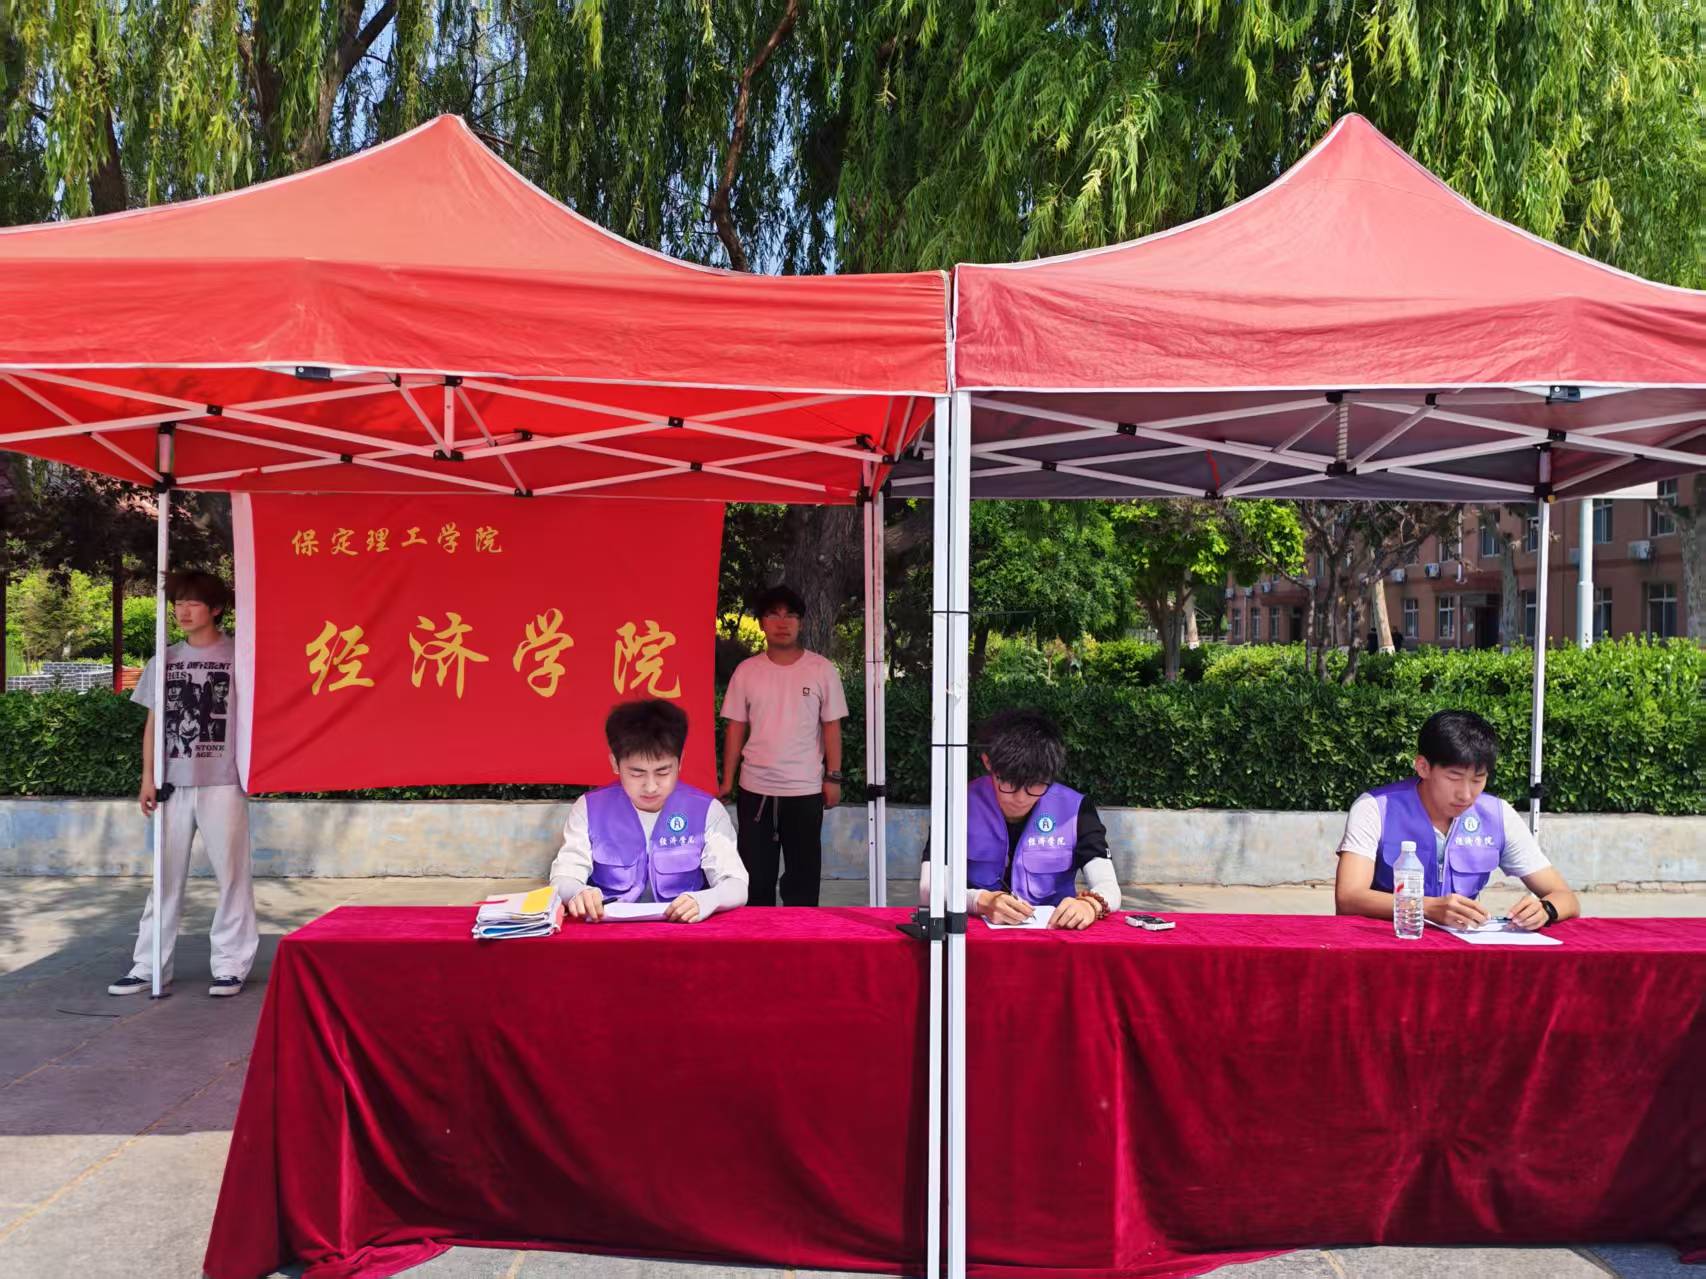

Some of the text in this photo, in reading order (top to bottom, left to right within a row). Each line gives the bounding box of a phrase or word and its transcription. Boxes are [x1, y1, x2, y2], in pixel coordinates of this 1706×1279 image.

[291, 523, 503, 556] 保定理工学院
[187, 661, 232, 670] DIFFERENT
[306, 608, 682, 699] 经济学院
